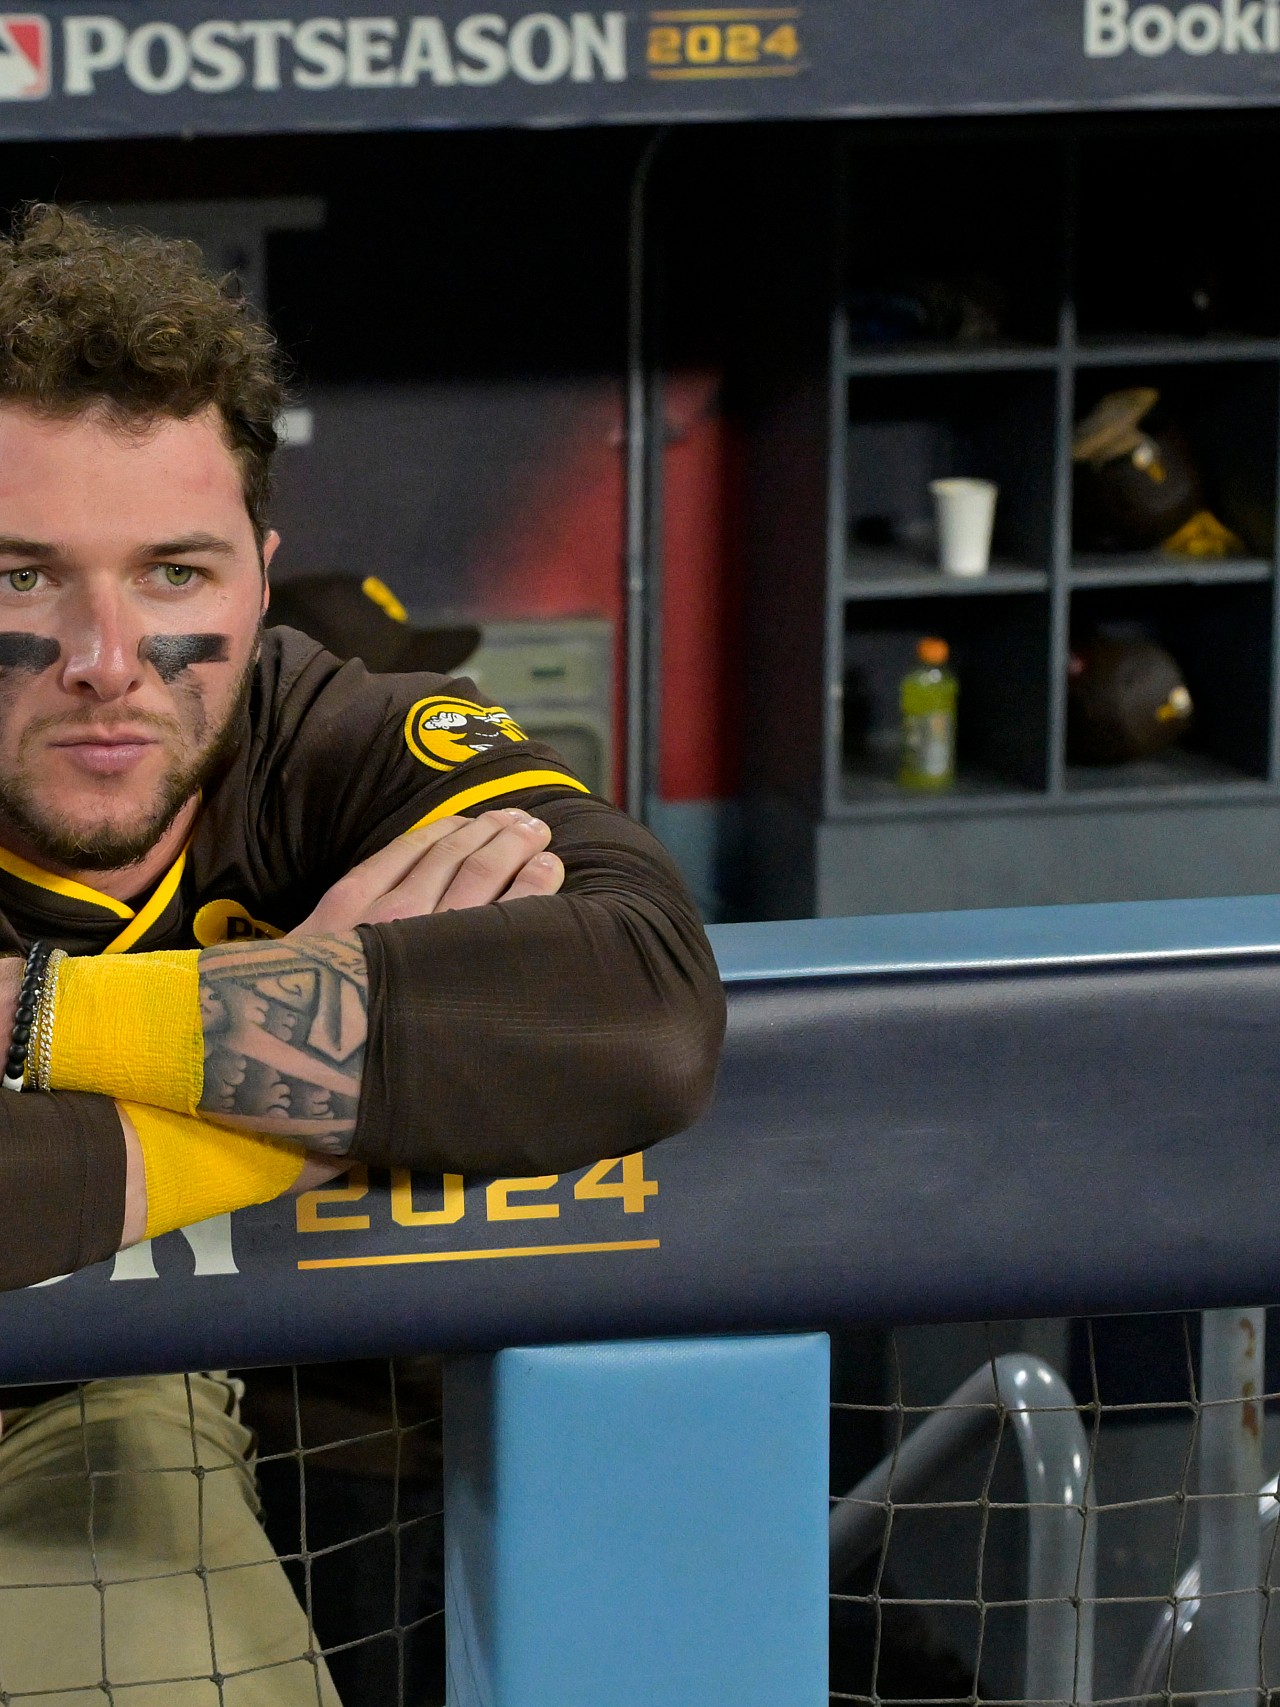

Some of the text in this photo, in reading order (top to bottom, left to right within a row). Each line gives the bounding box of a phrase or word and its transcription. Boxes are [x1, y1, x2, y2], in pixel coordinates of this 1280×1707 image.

[63, 10, 800, 93] POSTSEASON 2024
[295, 1152, 660, 1233] 2024
